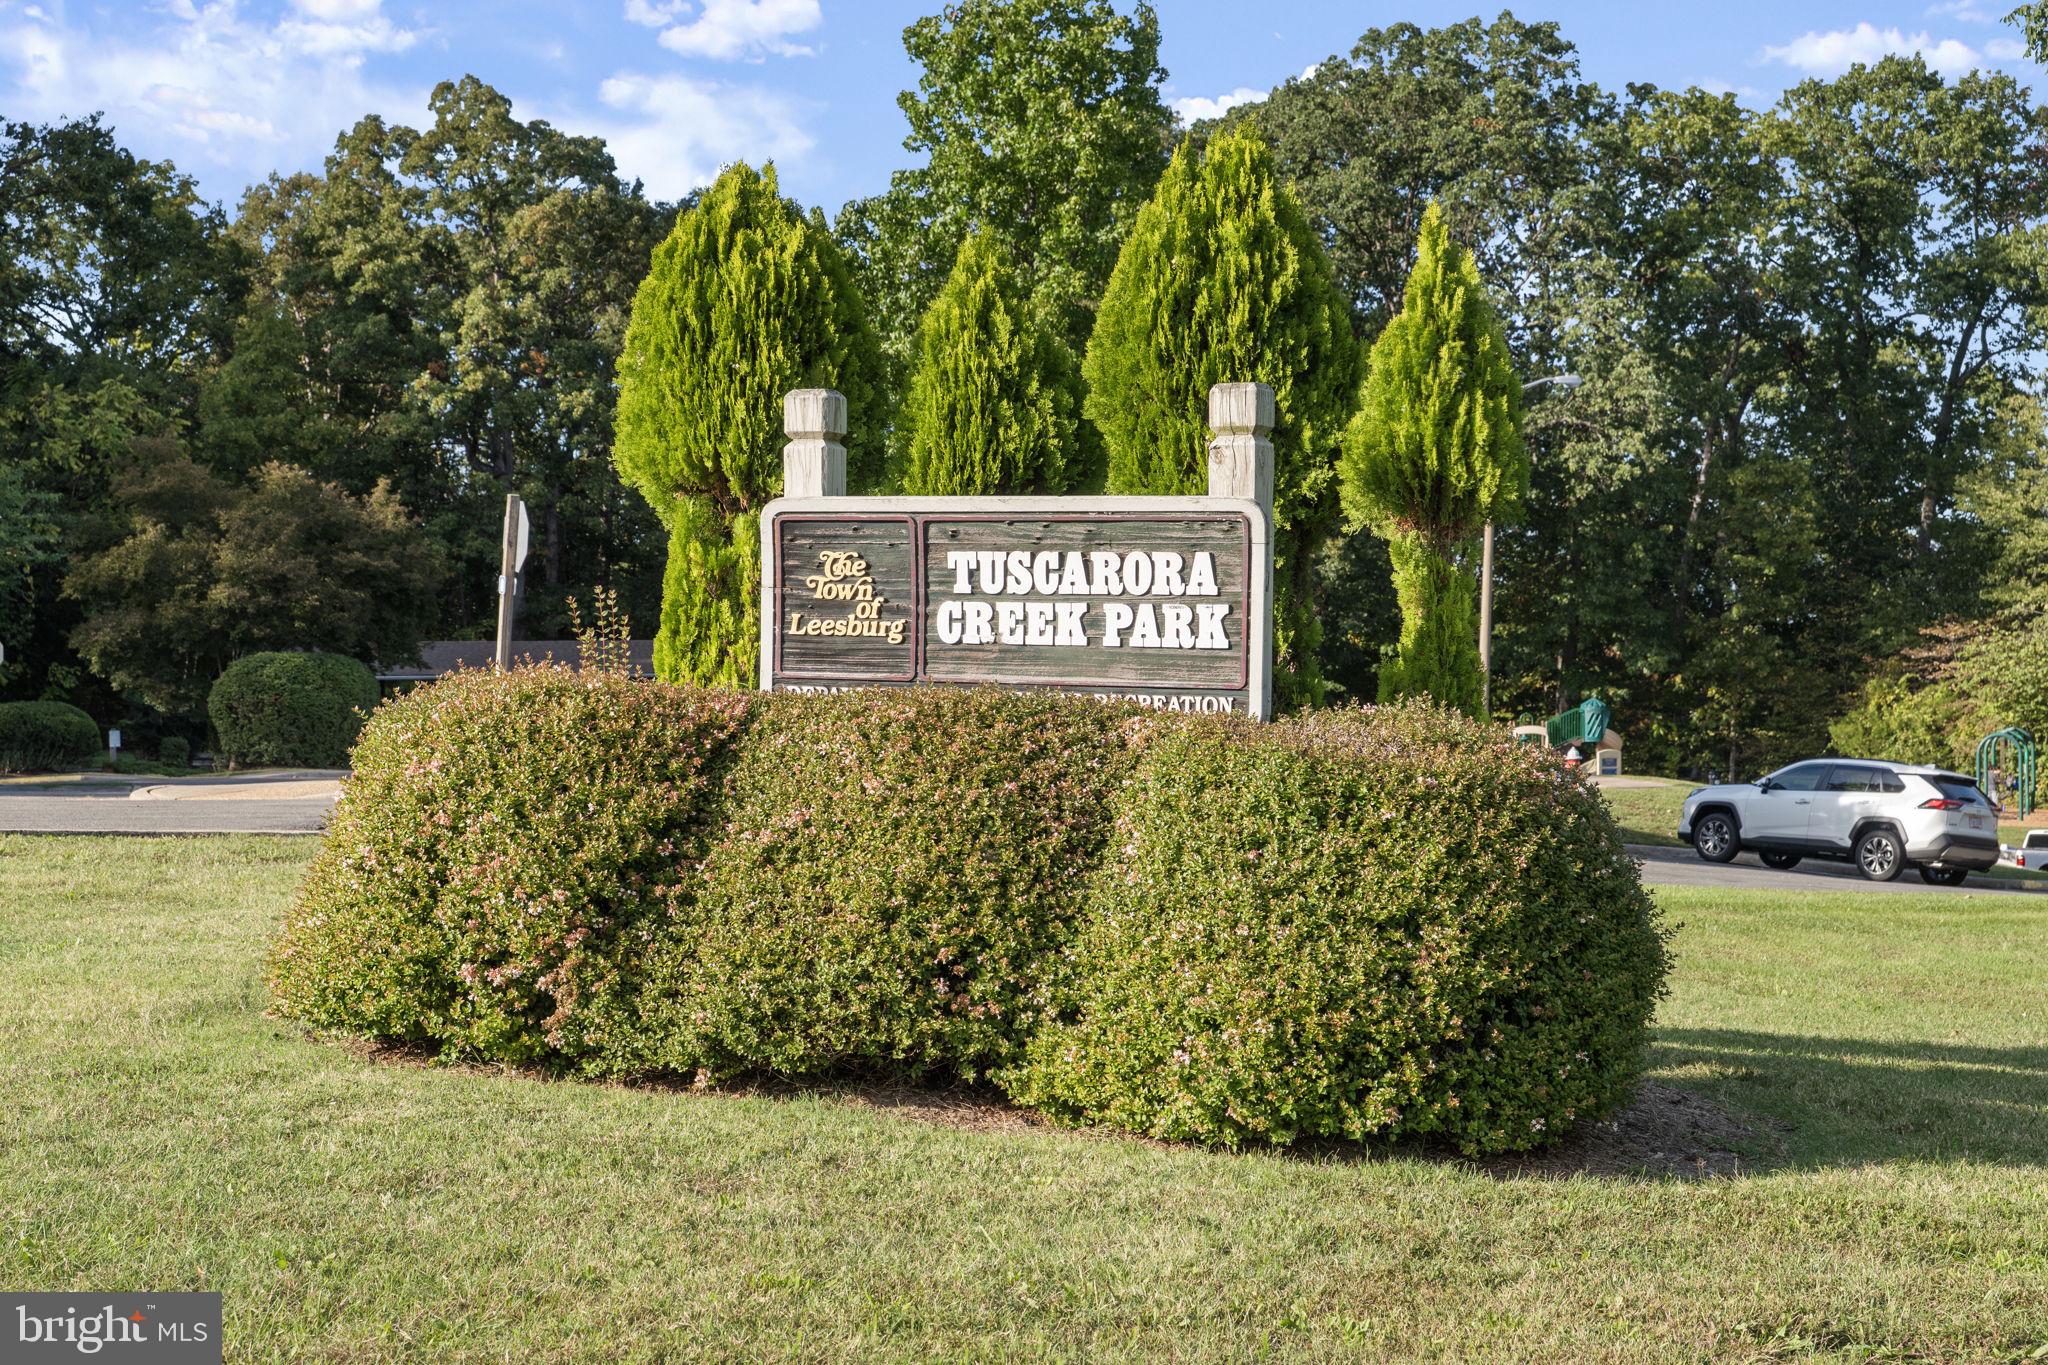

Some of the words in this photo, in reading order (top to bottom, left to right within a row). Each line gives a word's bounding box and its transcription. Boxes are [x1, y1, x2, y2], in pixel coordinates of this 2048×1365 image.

[819, 551, 867, 581] The
[947, 551, 1219, 596] TUSCARORA
[806, 575, 873, 601] Town
[856, 597, 884, 619] of
[788, 613, 906, 644] Leesburg
[936, 601, 1088, 646] CREEK
[1103, 603, 1230, 649] PARK
